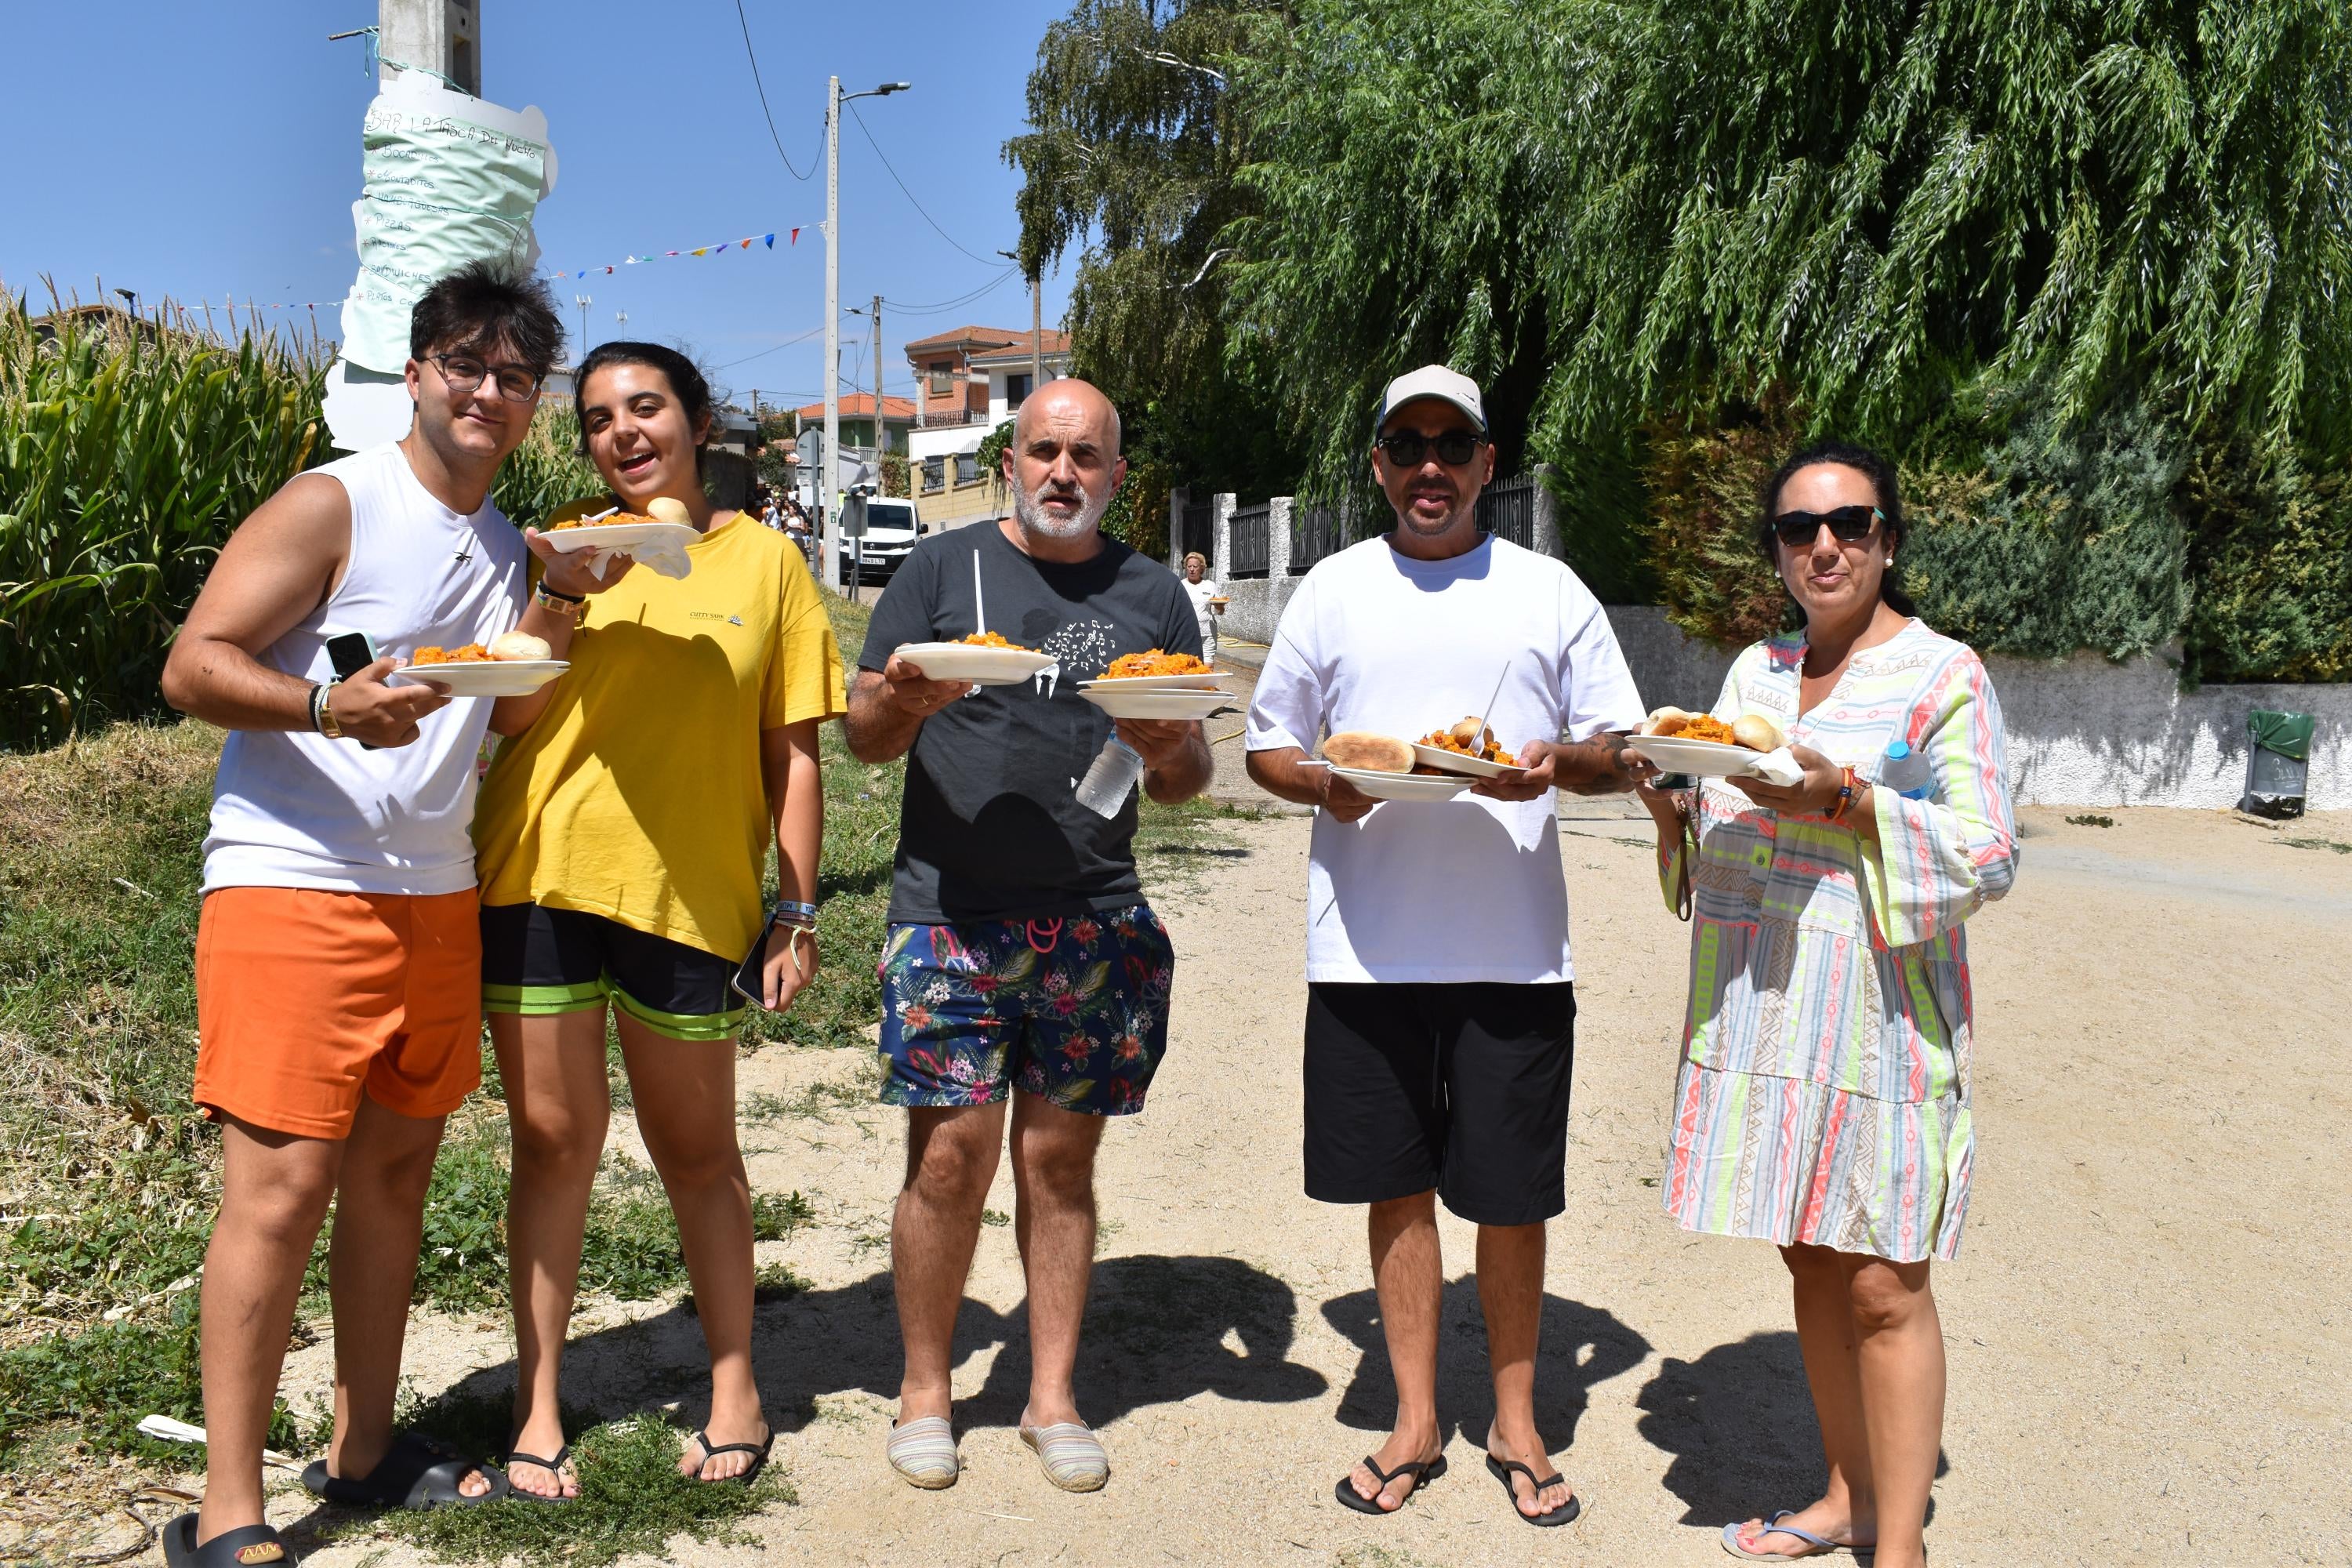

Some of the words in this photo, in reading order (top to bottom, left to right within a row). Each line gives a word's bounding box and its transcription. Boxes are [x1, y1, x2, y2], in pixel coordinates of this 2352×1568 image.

[366, 111, 402, 134] BAR
[410, 117, 431, 132] LA
[434, 117, 475, 140] TASCA
